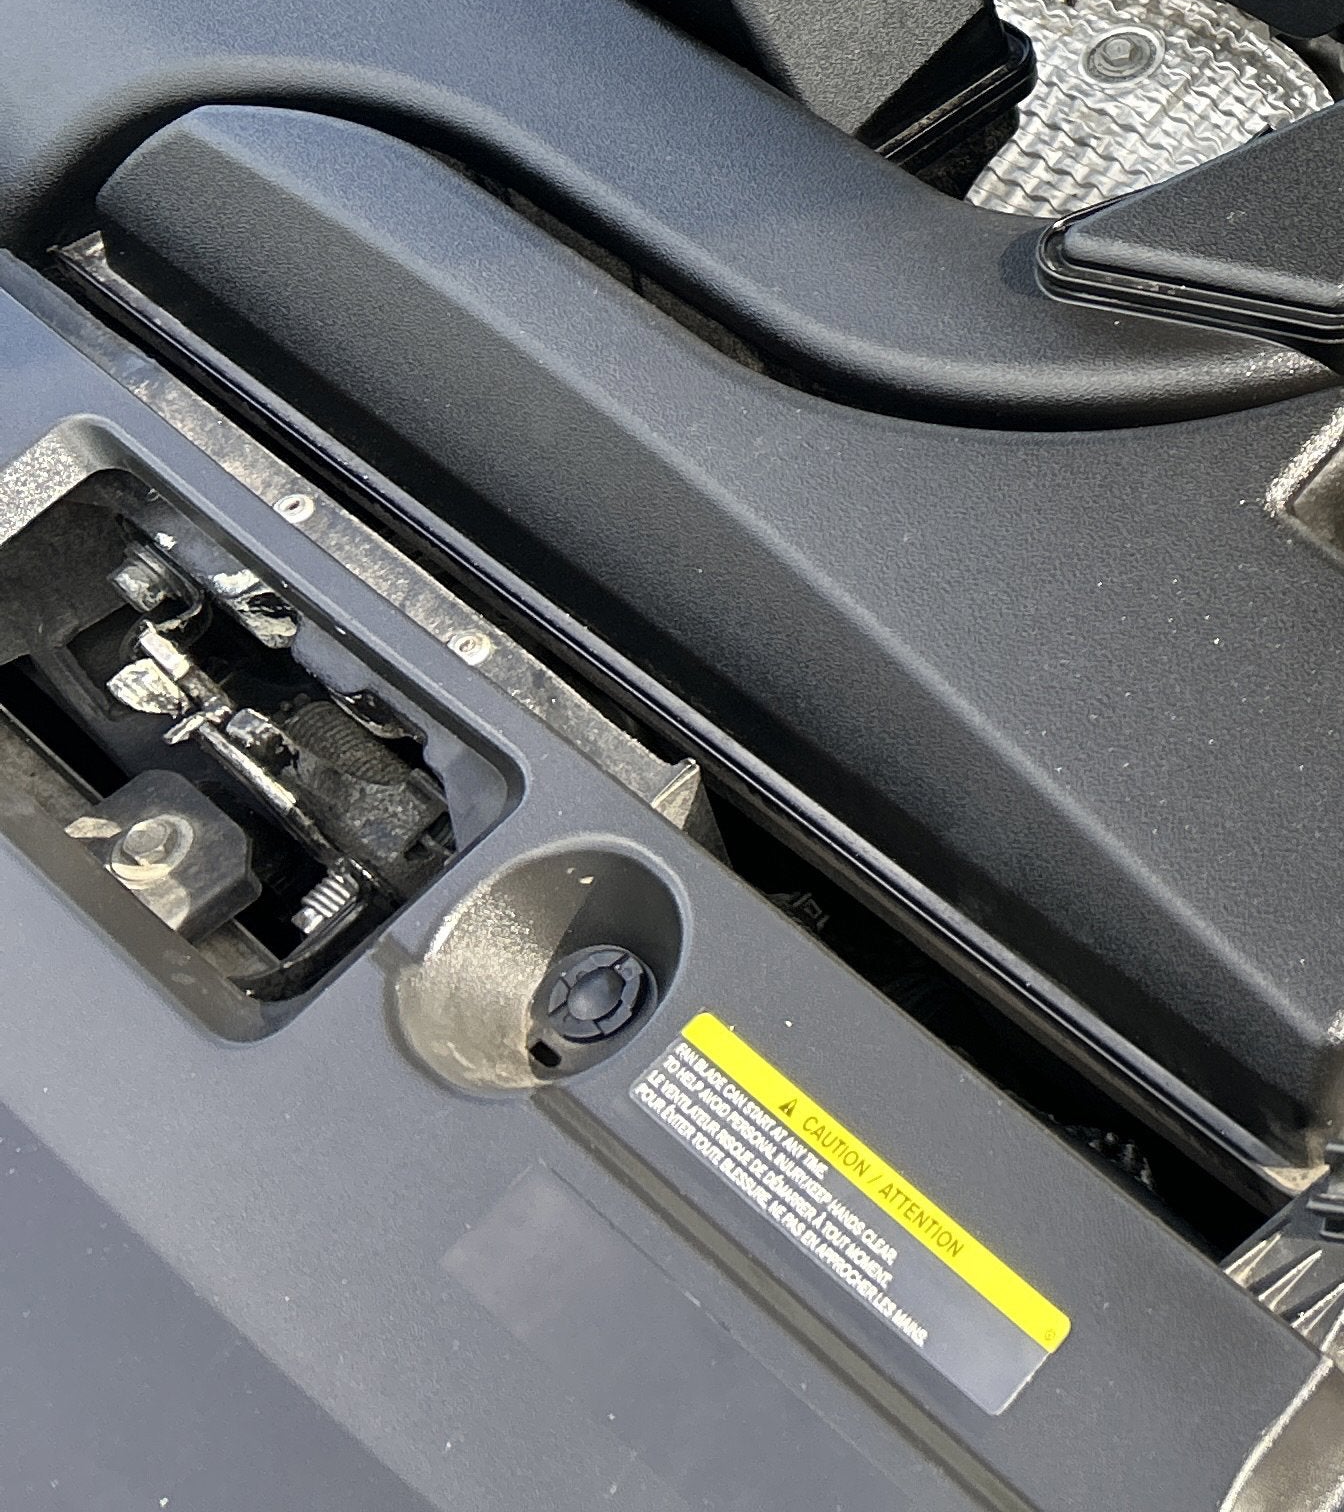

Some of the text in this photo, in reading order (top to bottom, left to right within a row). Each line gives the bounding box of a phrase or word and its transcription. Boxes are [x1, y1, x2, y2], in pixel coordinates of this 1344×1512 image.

[644, 1067, 666, 1089] LE
[657, 1078, 722, 1138] VENTILATEUR
[713, 1127, 755, 1167] RISQUE
[747, 1156, 769, 1179] DE
[818, 1219, 852, 1251] TOUT
[660, 1054, 682, 1075] TO
[673, 1065, 705, 1096] HELP
[696, 1085, 733, 1120] AVOID
[724, 1109, 780, 1161] PERSONAL
[825, 1197, 867, 1236] HANDS
[672, 1040, 700, 1066] FAN
[691, 1056, 728, 1091] BLADE
[720, 1082, 748, 1108] CAN
[740, 1099, 776, 1133] START
[767, 1123, 789, 1144] AT
[780, 1134, 807, 1160] ANY
[800, 1113, 871, 1178] CAUTION
[876, 1179, 964, 1259] ATTENTION
[630, 1081, 667, 1116] POUR
[688, 1131, 726, 1167] TOUTE
[765, 1198, 788, 1221] NE
[779, 1210, 807, 1238] PAS
[799, 1227, 822, 1250] EN
[813, 1240, 881, 1301] APPROCHER
[871, 1290, 899, 1317] LES
